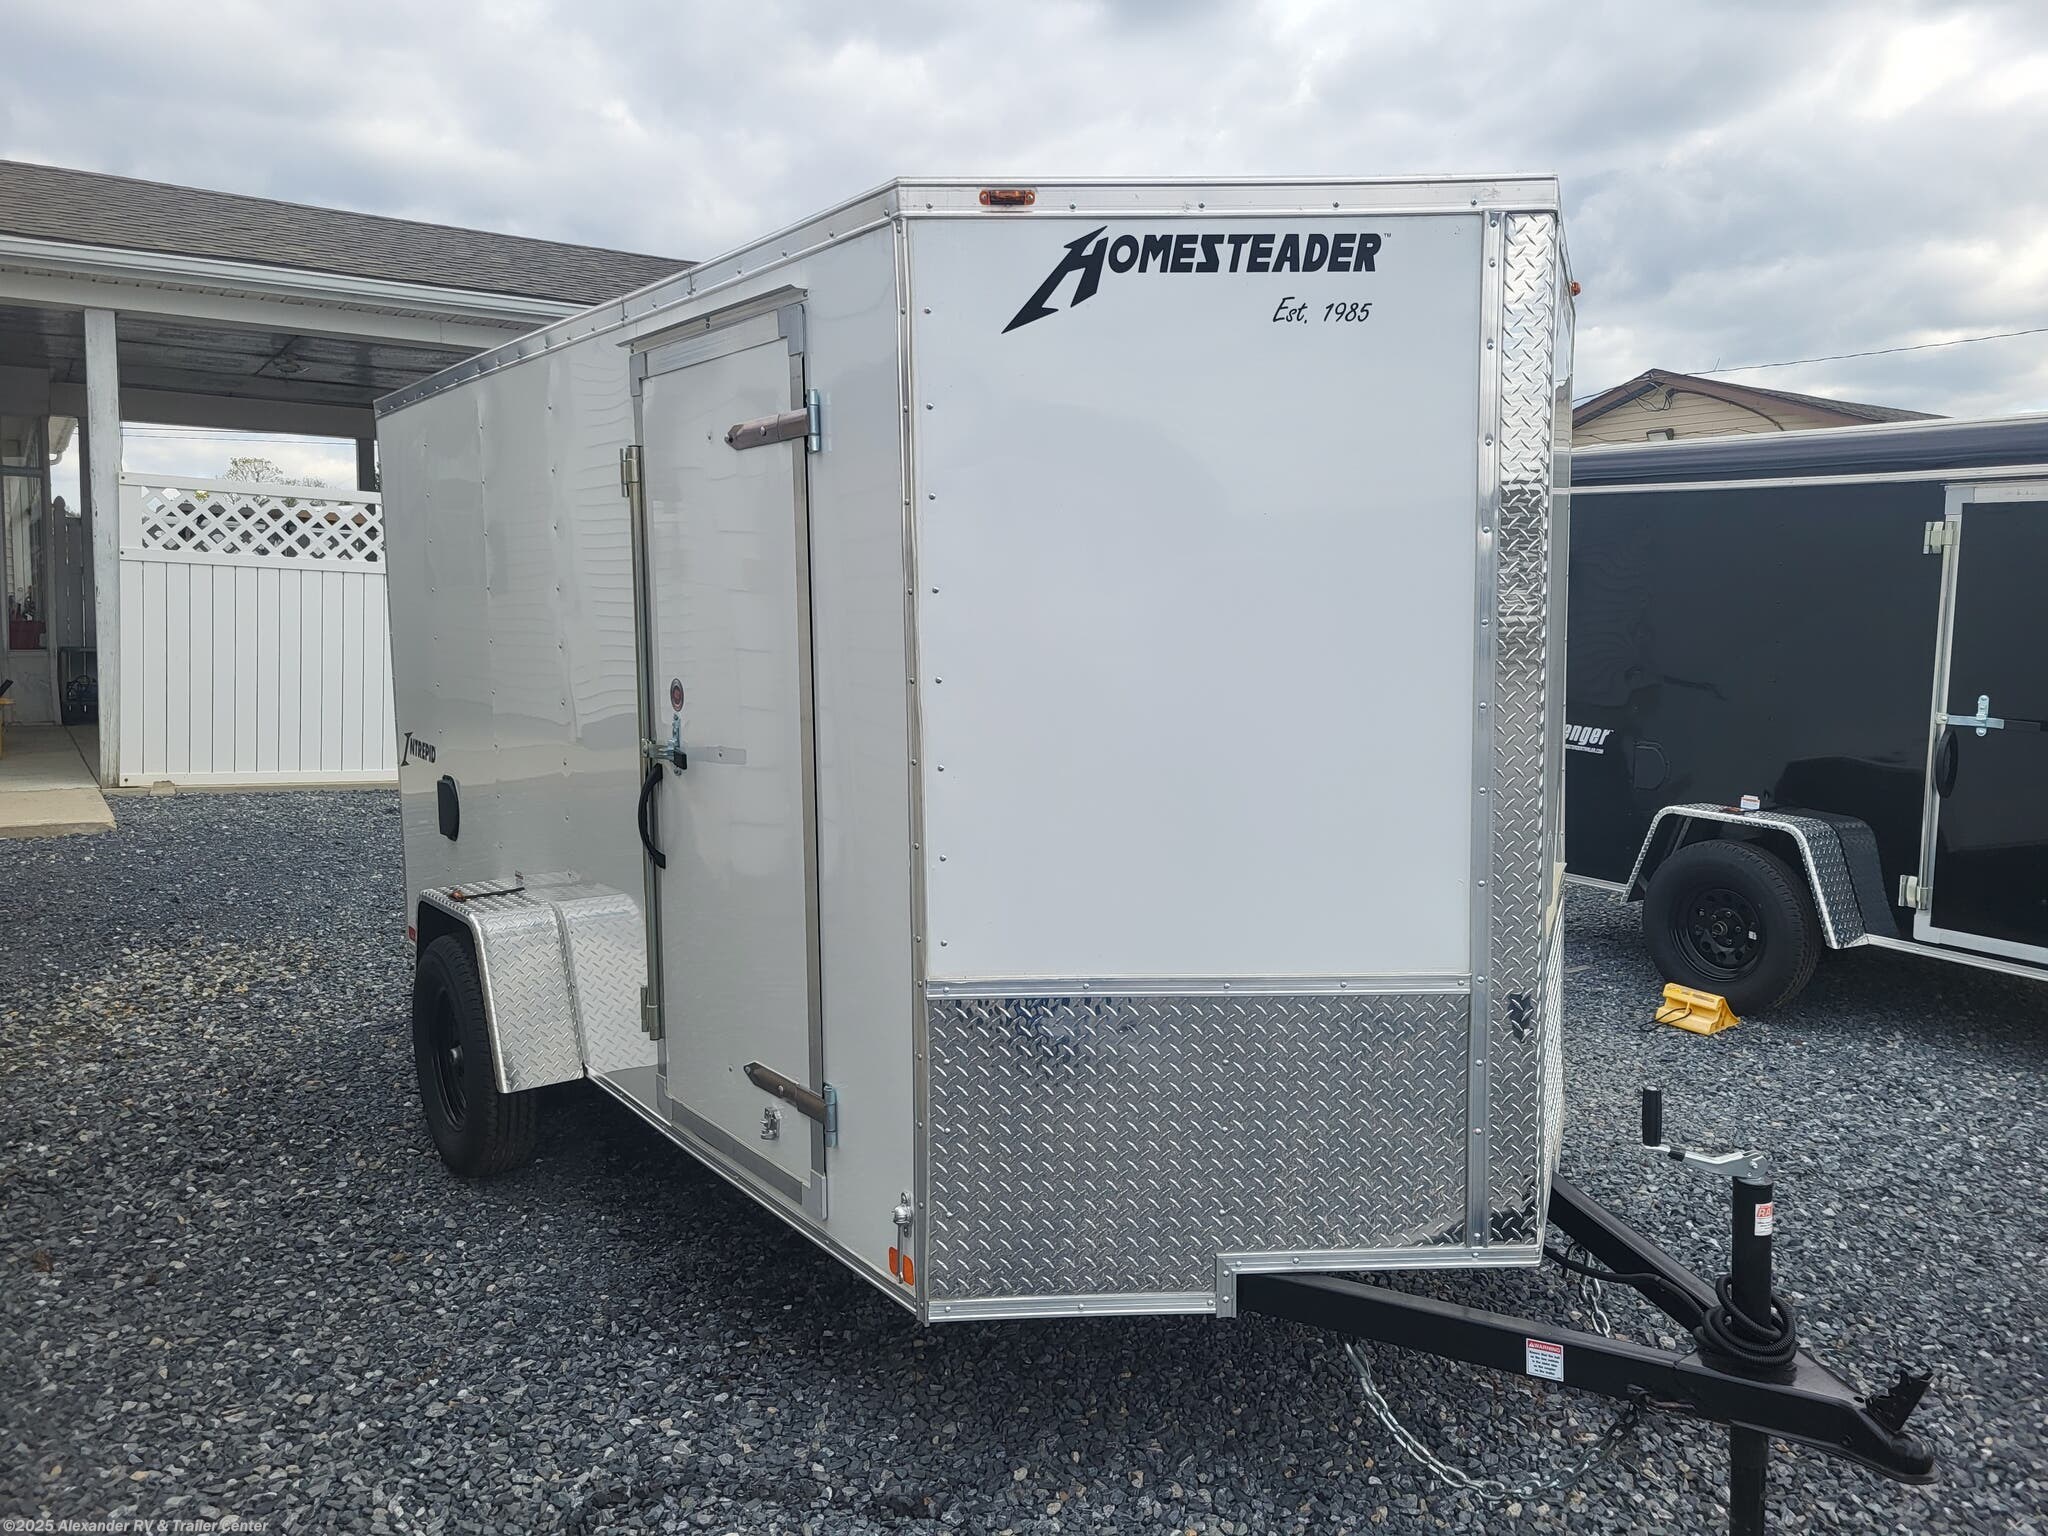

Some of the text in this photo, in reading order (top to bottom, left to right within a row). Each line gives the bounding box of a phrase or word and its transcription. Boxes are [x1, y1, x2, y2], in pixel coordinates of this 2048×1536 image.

[1001, 225, 1382, 334] HOMESTEADER
[1272, 296, 1373, 324] Est. 1985
[1533, 1343, 1561, 1353] WARNING
